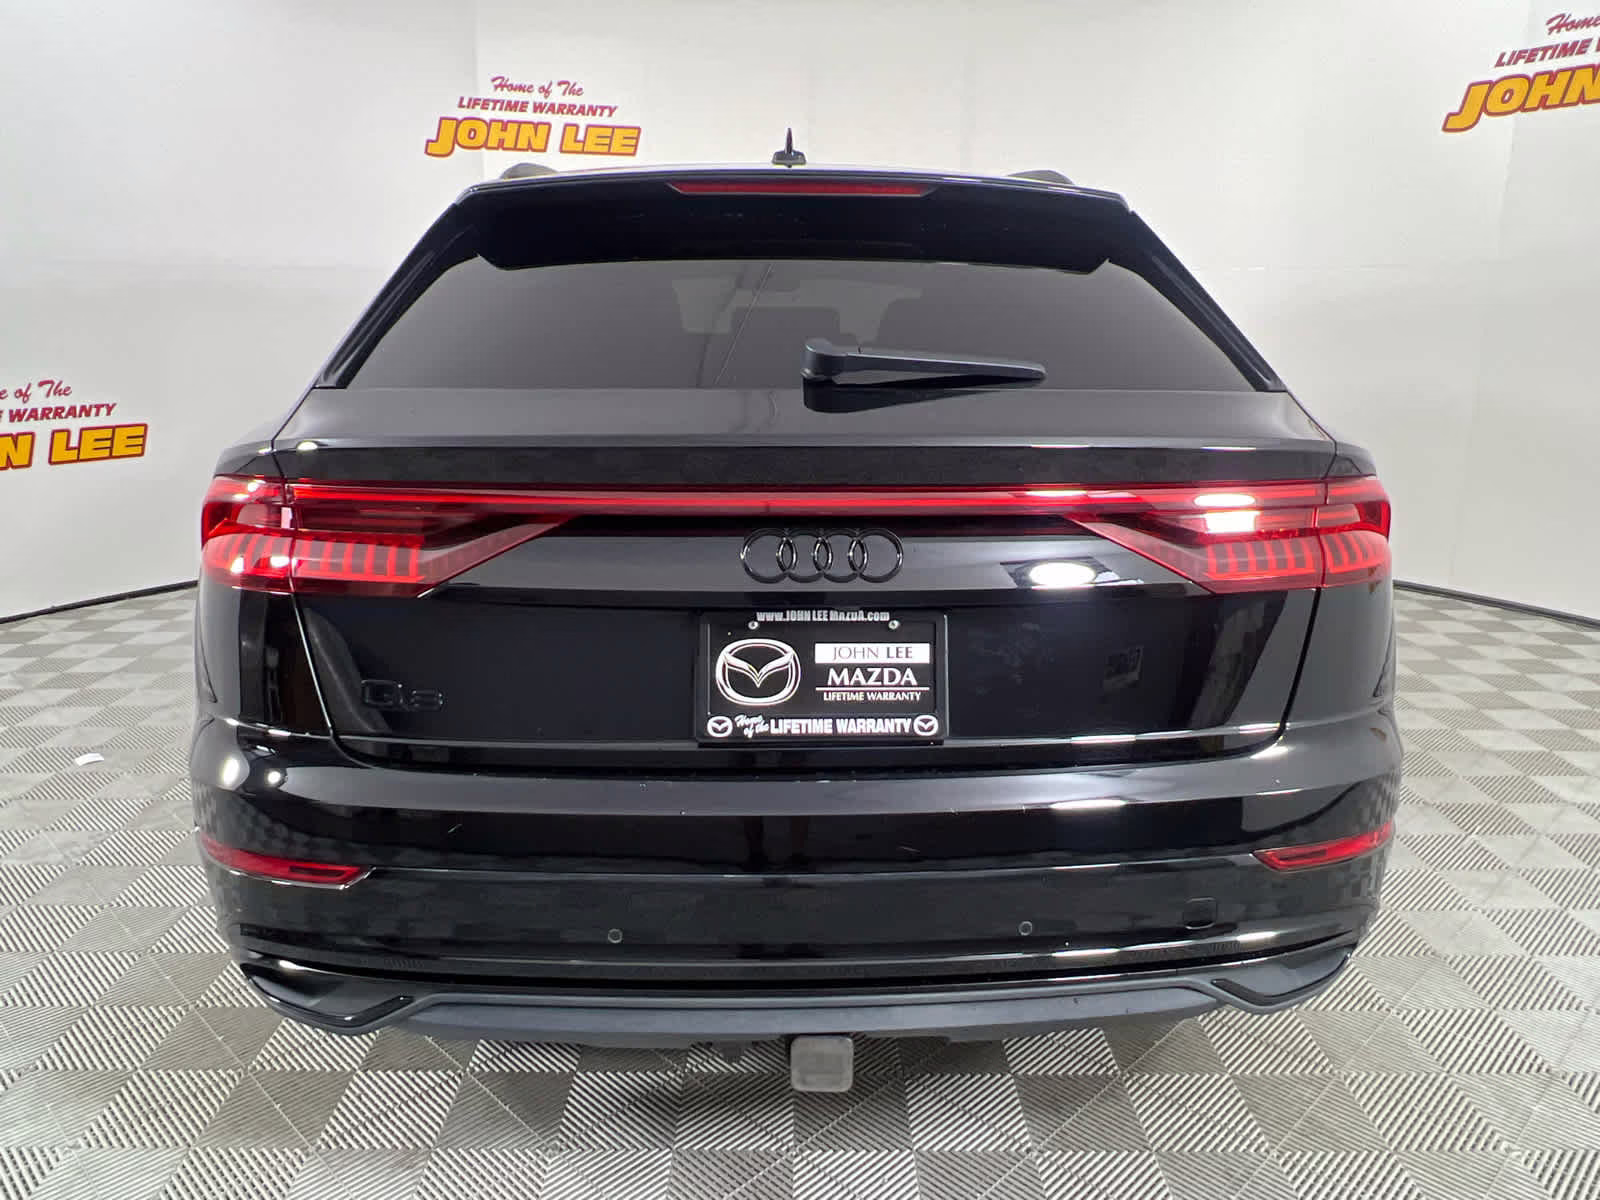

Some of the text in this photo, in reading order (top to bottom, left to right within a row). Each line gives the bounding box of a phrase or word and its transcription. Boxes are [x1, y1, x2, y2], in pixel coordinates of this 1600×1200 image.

[1545, 12, 1600, 35] Home
[1494, 38, 1593, 68] LIFETIME
[491, 76, 584, 98] Home of The
[1442, 64, 1600, 132] JOHN
[457, 97, 617, 117] LIFETIME WARRANTY
[425, 117, 641, 157] JOHN LEE
[14, 383, 32, 404] of
[37, 380, 72, 398] The
[8, 403, 117, 422] WARRANTY
[48, 423, 148, 465] LEE
[832, 646, 913, 660] JOHN LEE
[827, 667, 918, 686] MAZDA
[823, 691, 922, 701] LIFETIME WARRANTY
[770, 718, 912, 734] LIFETIME WARRANTY
